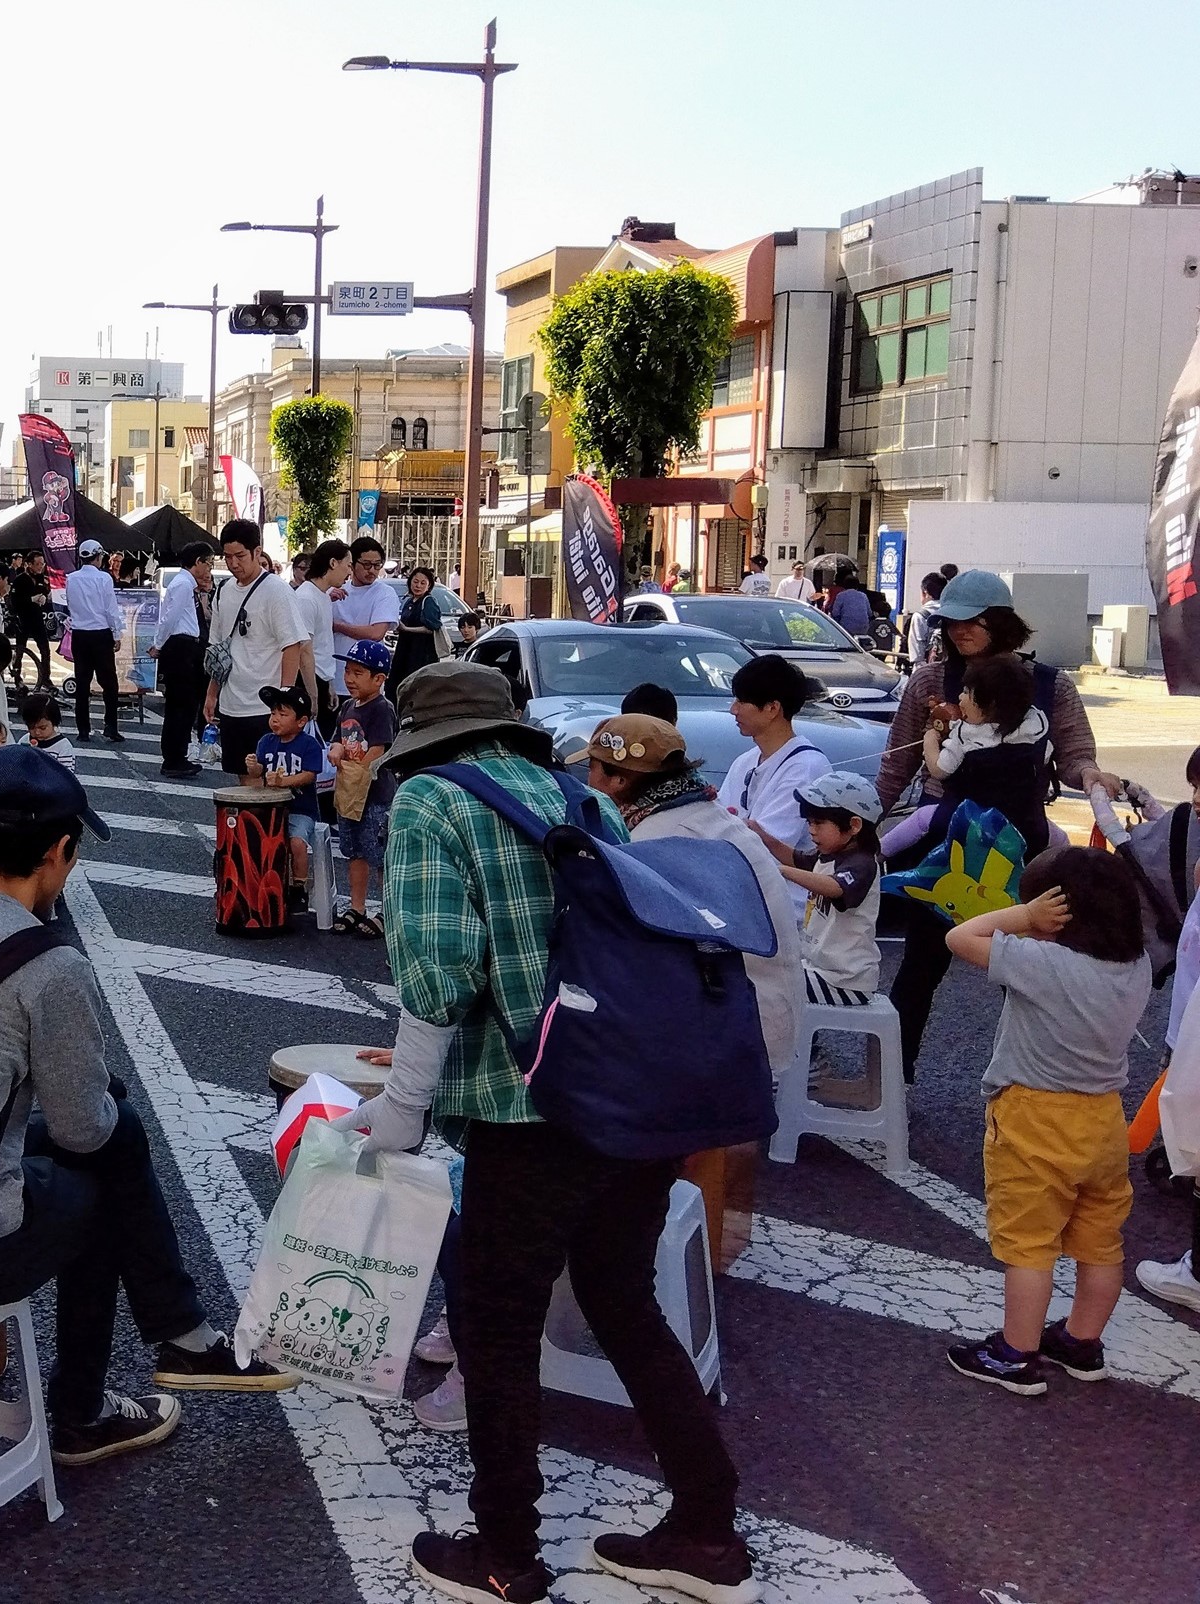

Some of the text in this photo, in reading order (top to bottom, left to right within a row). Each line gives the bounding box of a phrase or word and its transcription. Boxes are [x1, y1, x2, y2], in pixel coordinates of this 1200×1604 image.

[339, 286, 408, 300] 泉町2丁目
[78, 372, 144, 387] 第一興商
[880, 573, 897, 583] BOSS
[265, 751, 302, 776] GAP
